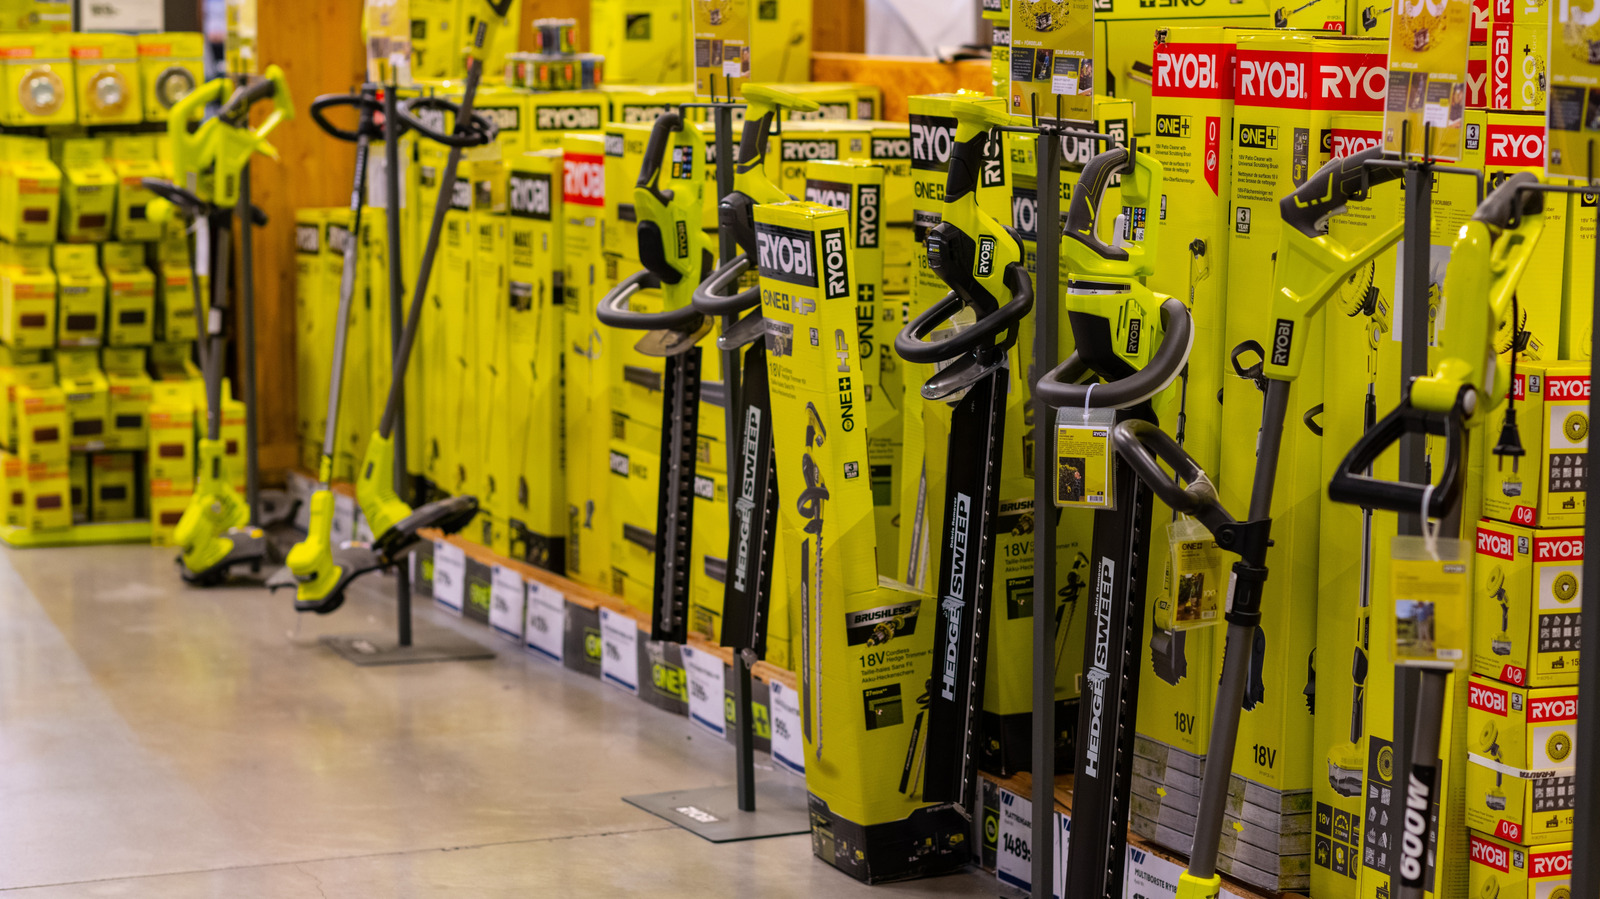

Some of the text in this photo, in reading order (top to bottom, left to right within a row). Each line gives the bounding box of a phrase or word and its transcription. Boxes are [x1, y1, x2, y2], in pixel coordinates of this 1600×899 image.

[1156, 53, 1216, 89] RYOBI
[1240, 60, 1305, 99] RYOBI
[1320, 65, 1388, 100] RYO
[538, 108, 599, 130] RYOBI
[1157, 117, 1190, 136] ONE+
[1209, 121, 1216, 141] 0
[1241, 127, 1277, 147] ONE+
[1470, 126, 1476, 138] 3
[783, 142, 837, 160] RYOBI
[873, 139, 911, 157] RYO
[911, 124, 956, 163] RYO
[1333, 135, 1383, 160] RYO
[1491, 133, 1546, 159] RYO
[914, 180, 944, 201] ONE+
[860, 187, 878, 246] RYOBI
[1238, 223, 1249, 231] YEAR
[1240, 210, 1247, 222] 3
[757, 231, 816, 277] RYOBI
[825, 231, 845, 297] RYOBI
[918, 254, 930, 269] 18
[979, 240, 991, 274] RYOBI
[763, 289, 817, 316] ONE+ HP
[1128, 320, 1140, 352] RYOBI
[1273, 322, 1291, 364] RYOBI
[834, 328, 855, 432] ONE+ HP
[1549, 380, 1591, 397] RYOB
[848, 463, 854, 471] 3
[734, 411, 760, 593] HEDGE SWEEP
[1000, 501, 1034, 513] BRUSH
[1517, 506, 1523, 520] 0
[1004, 541, 1030, 558] 18V
[1181, 542, 1203, 551] ONE+
[1477, 532, 1512, 557] RYOBI
[1538, 540, 1583, 558] RYOB
[1005, 564, 1034, 573] Akku-Heck
[941, 498, 969, 702] HEDGE SWEEP
[854, 605, 912, 624] BRUSHLESS
[859, 647, 910, 669] 18V Cordless
[905, 651, 926, 660] Trimmer
[1085, 562, 1114, 778] HEDGE SWEEP
[1507, 666, 1513, 679] 0
[1470, 686, 1506, 713] RYOBI
[1174, 710, 1195, 735] 18V
[1253, 743, 1277, 769] 18V
[1519, 770, 1556, 779] K-RAUTA
[1318, 813, 1331, 826] 18V
[1400, 772, 1430, 881] 600W
[1502, 821, 1509, 834] 0
[1565, 816, 1573, 825] 15
[1003, 832, 1031, 863] 1489:
[1471, 841, 1507, 868] RYOBI
[1534, 855, 1573, 874] RYO
[1134, 868, 1178, 894] MULTIBORSTE RY18
